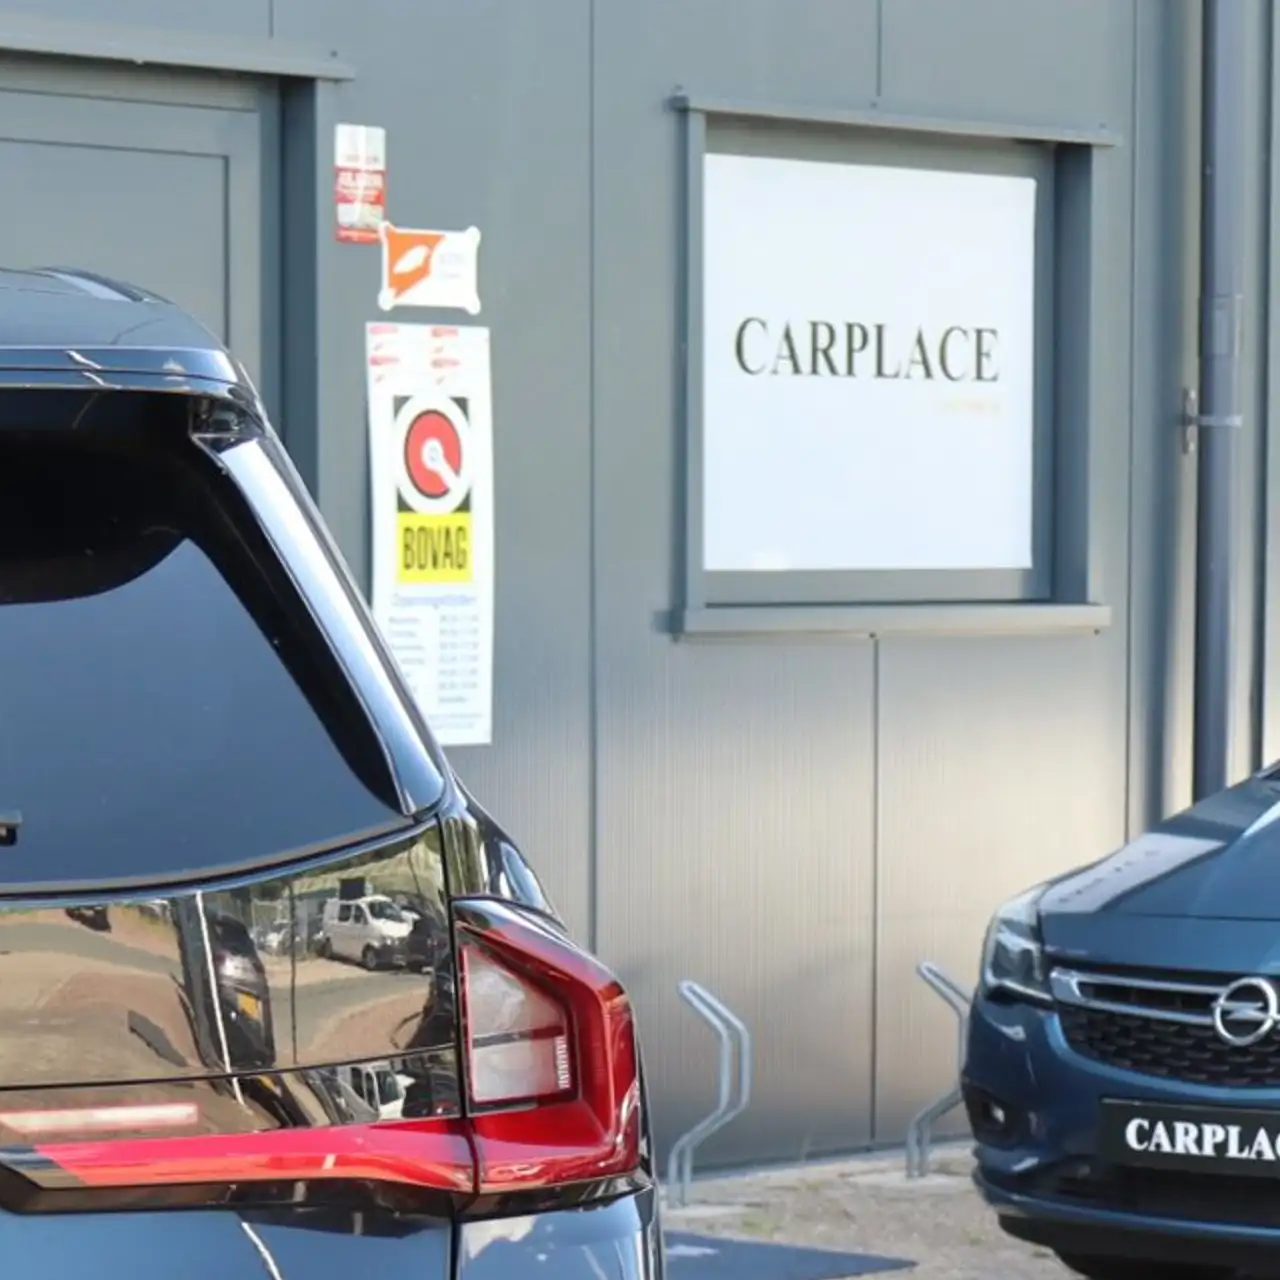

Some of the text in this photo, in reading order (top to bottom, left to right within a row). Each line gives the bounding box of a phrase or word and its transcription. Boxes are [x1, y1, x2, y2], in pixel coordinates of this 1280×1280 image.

[735, 317, 1000, 382] CARPLACE
[403, 525, 468, 570] BOVAG
[1125, 1118, 1280, 1161] CARPLA
